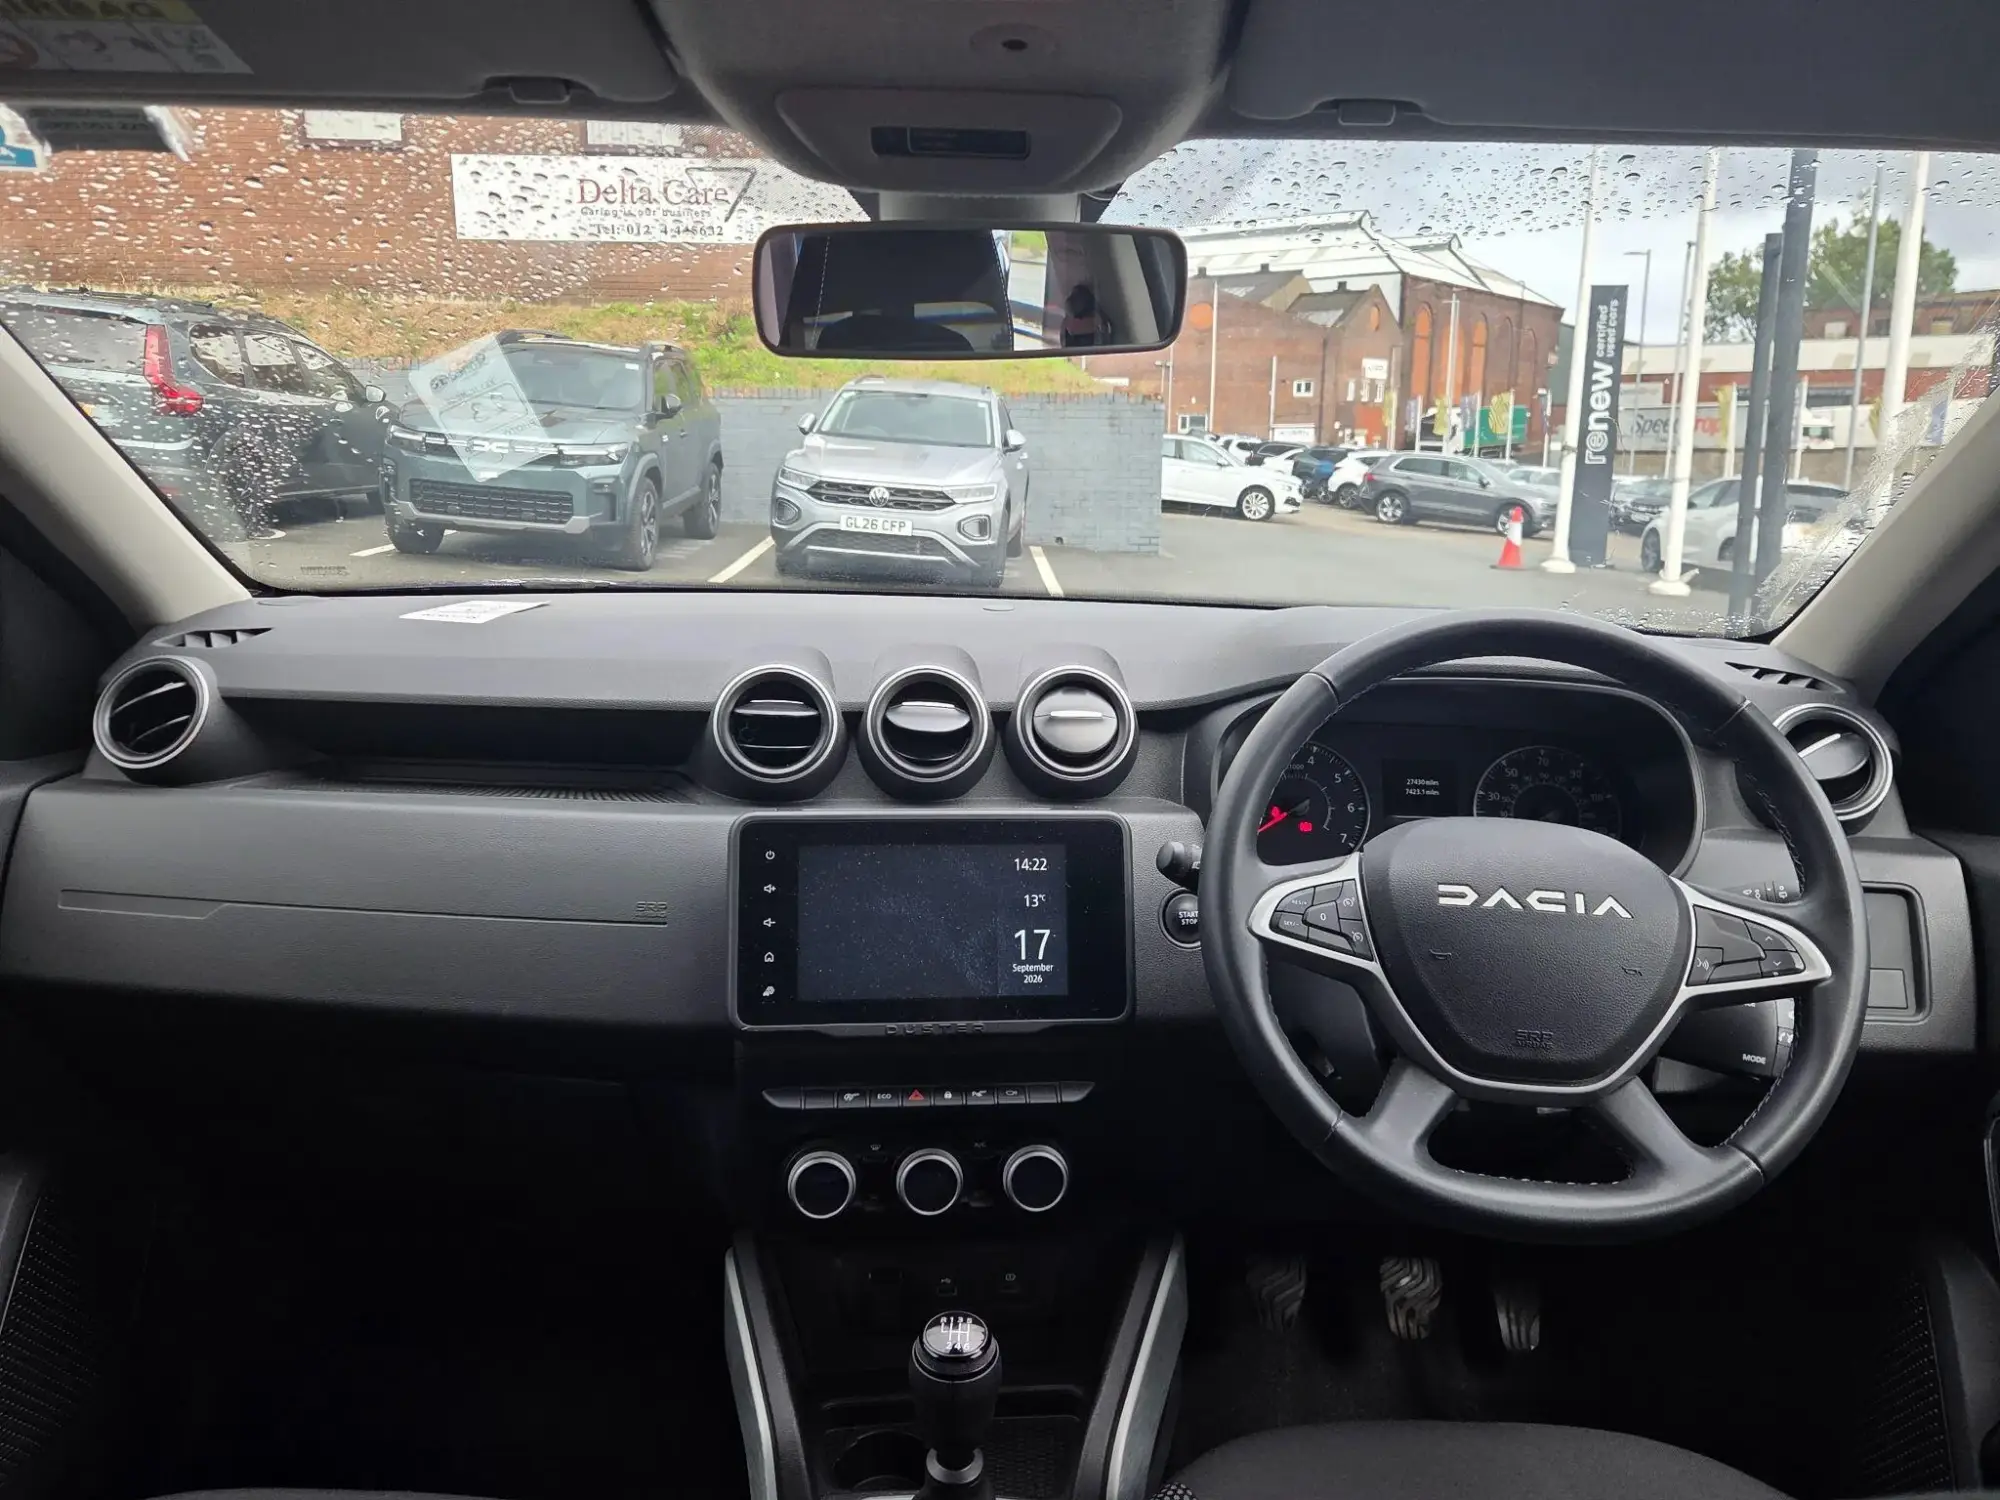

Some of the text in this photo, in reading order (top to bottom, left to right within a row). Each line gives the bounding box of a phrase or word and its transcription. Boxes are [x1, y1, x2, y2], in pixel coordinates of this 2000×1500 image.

[576, 176, 730, 206] Delta Care
[1596, 304, 1608, 357] certified
[1606, 298, 1619, 358] used cars
[1585, 360, 1614, 465] renew
[845, 516, 906, 533] GL26 CFP
[1306, 755, 1315, 766] 4
[1504, 767, 1518, 778] 50
[1334, 773, 1342, 784] 5
[1486, 791, 1500, 802] 30
[1347, 802, 1356, 813] 6
[1340, 833, 1348, 843] 7
[1014, 858, 1047, 871] 14:22
[1437, 883, 1634, 919] DACIA
[1178, 911, 1199, 919] START
[1181, 918, 1198, 926] STOP
[1014, 929, 1051, 960] 17
[1012, 963, 1054, 974] September
[1023, 974, 1043, 984] 2026
[886, 1022, 985, 1036] DUSTER
[1742, 1053, 1767, 1065] MODE
[946, 1341, 952, 1350] 2
[954, 1342, 962, 1350] 4
